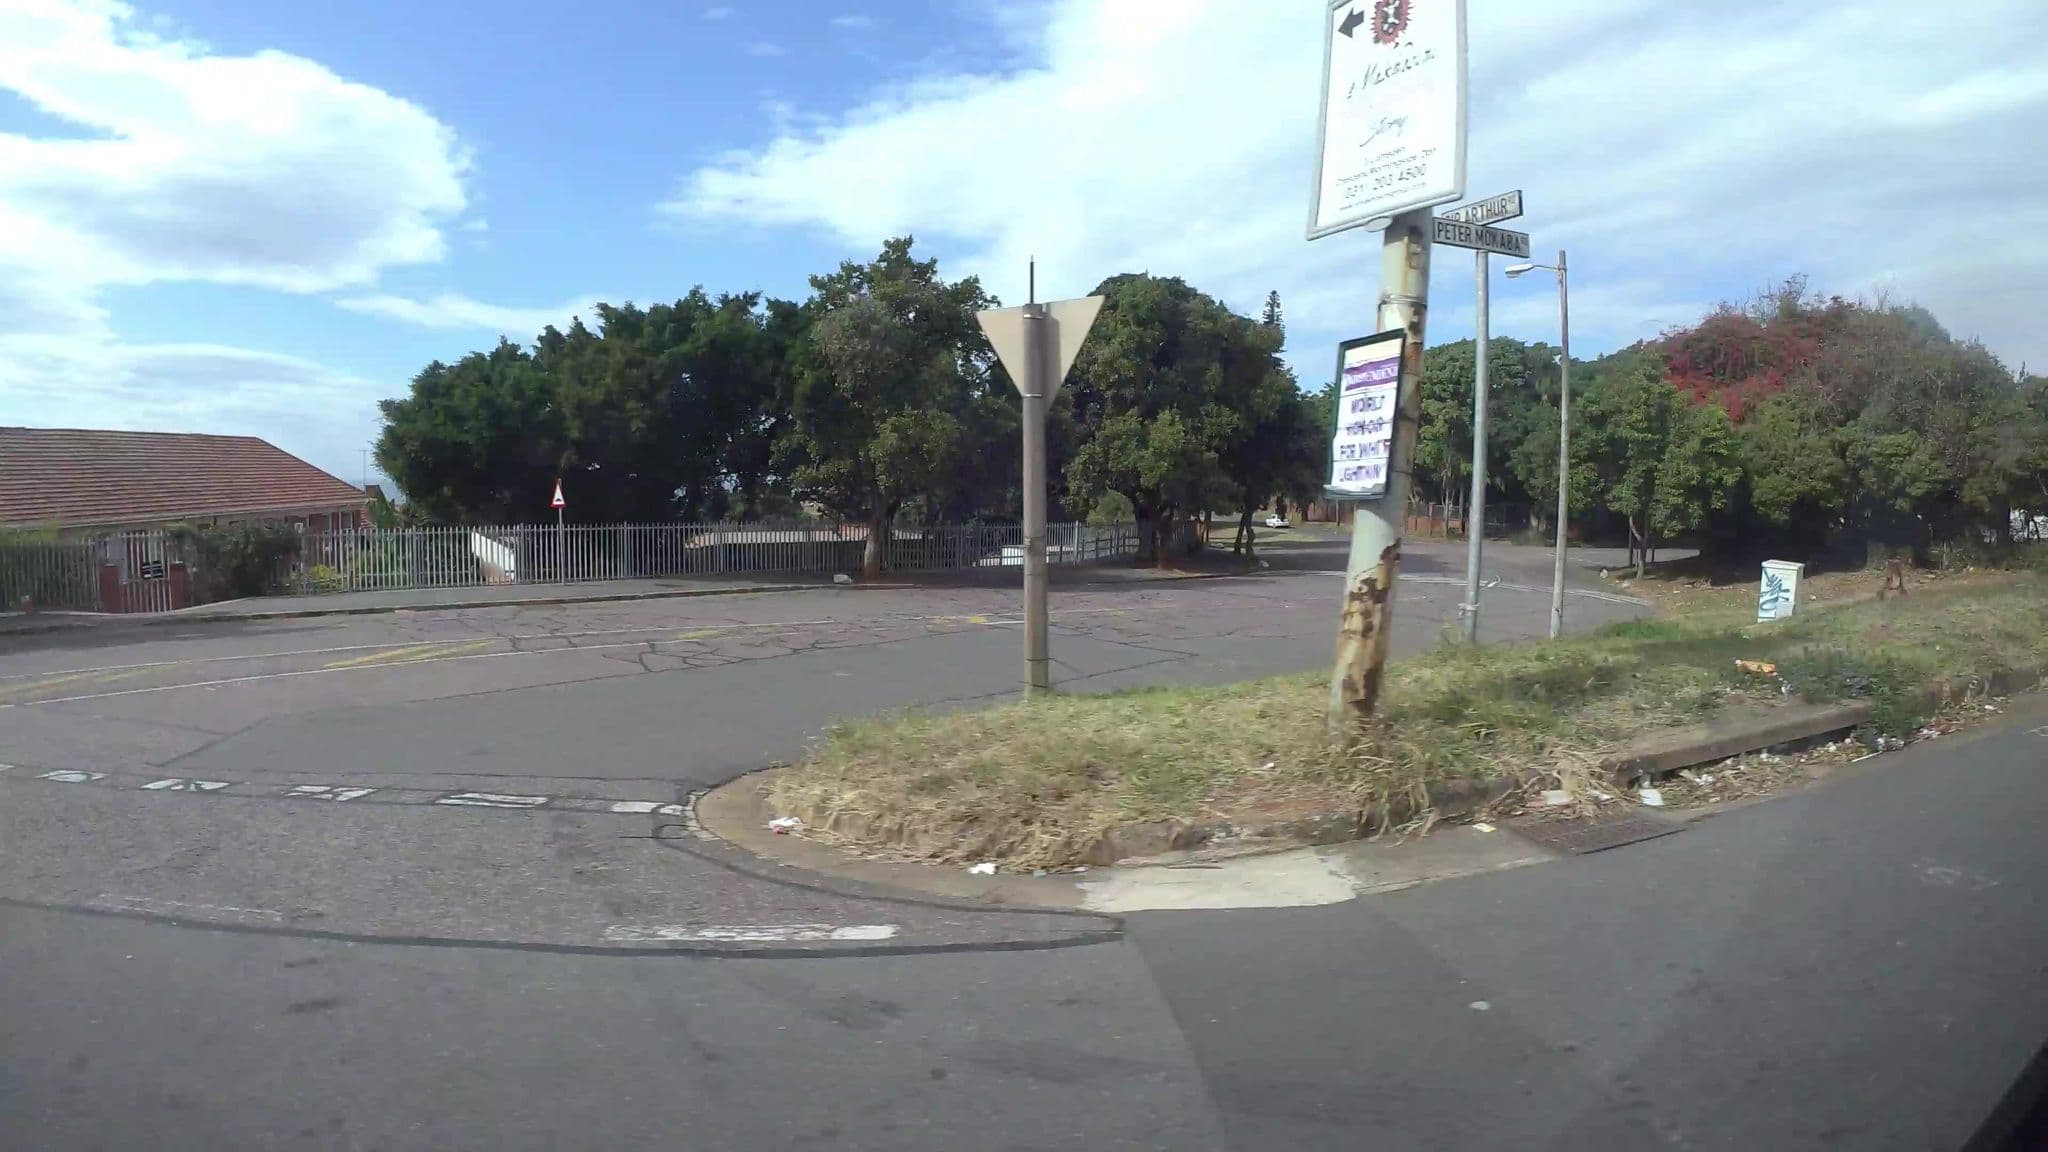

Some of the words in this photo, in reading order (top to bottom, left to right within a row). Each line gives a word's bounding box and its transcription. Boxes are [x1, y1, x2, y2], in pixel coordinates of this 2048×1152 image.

[1465, 198, 1507, 222] ARTHUR
[1437, 222, 1472, 244] PETER
[1475, 229, 1521, 251] MOKABA
